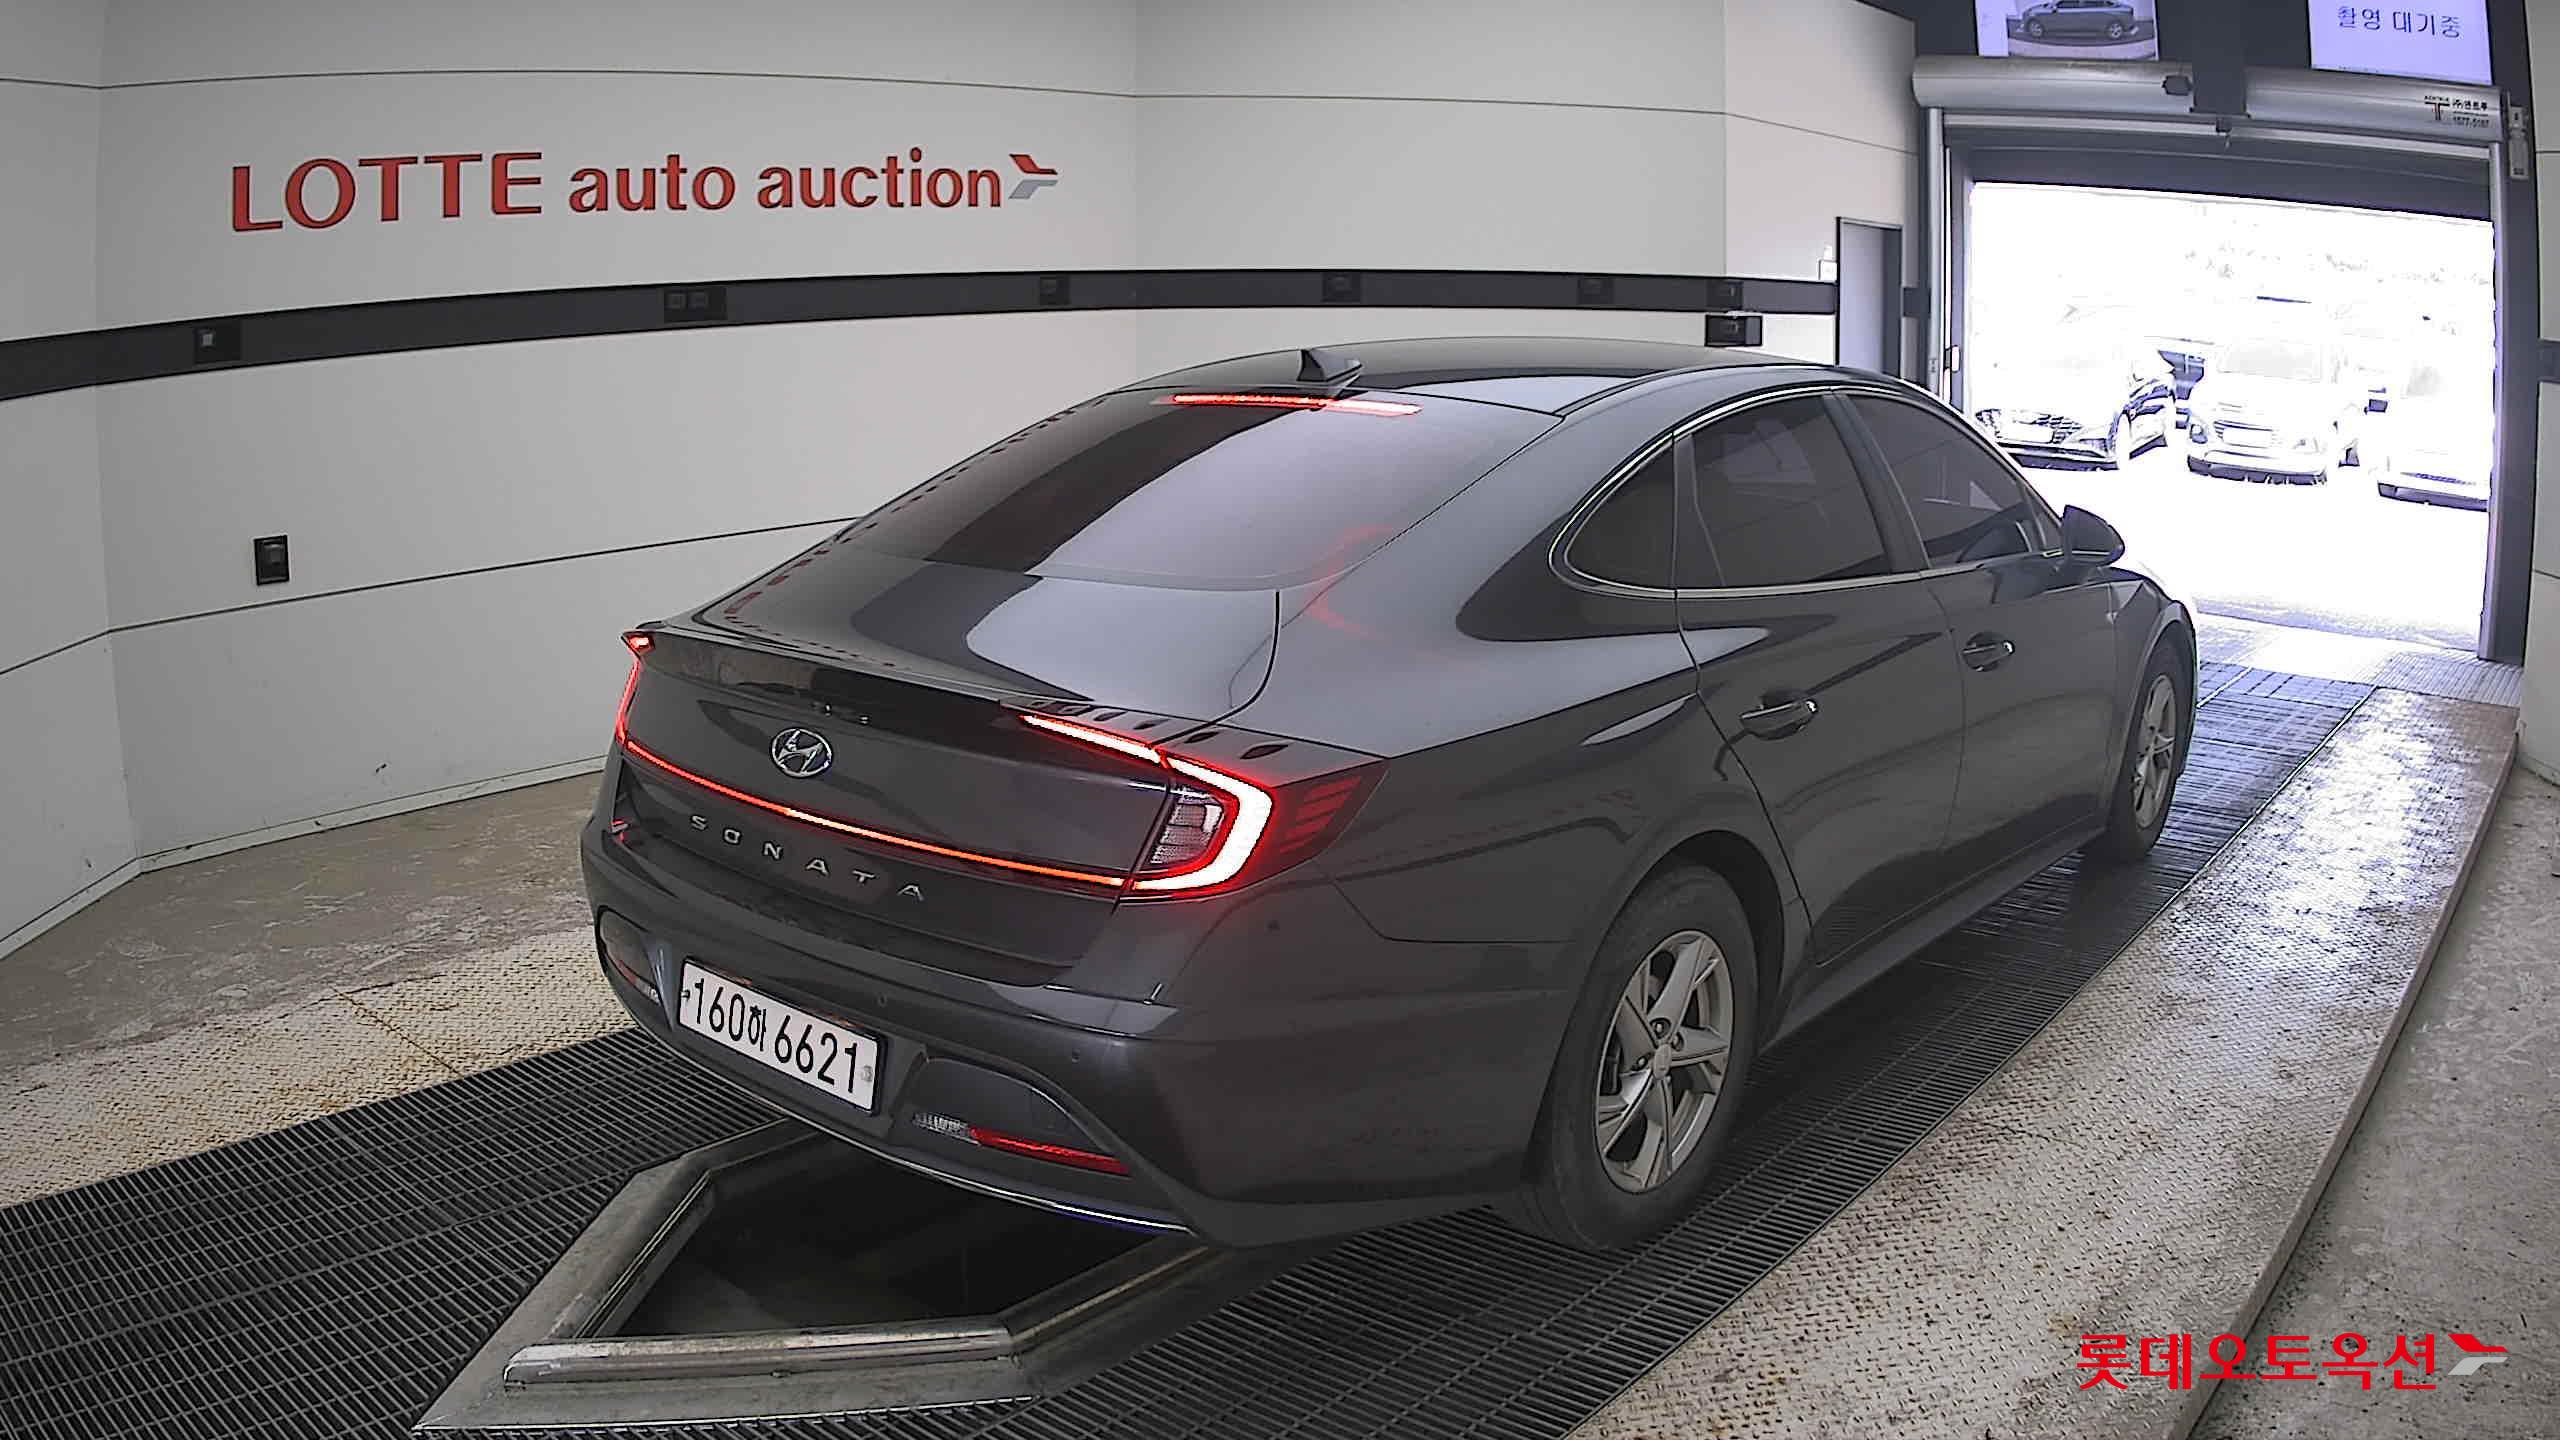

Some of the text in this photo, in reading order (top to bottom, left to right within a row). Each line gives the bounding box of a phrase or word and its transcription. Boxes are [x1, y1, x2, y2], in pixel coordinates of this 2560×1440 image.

[2337, 6, 2461, 39] 촬영 대기중
[232, 147, 1002, 232] LOTTE auto auction
[690, 814, 924, 902] SONATA
[694, 978, 858, 1094] 160하 6621
